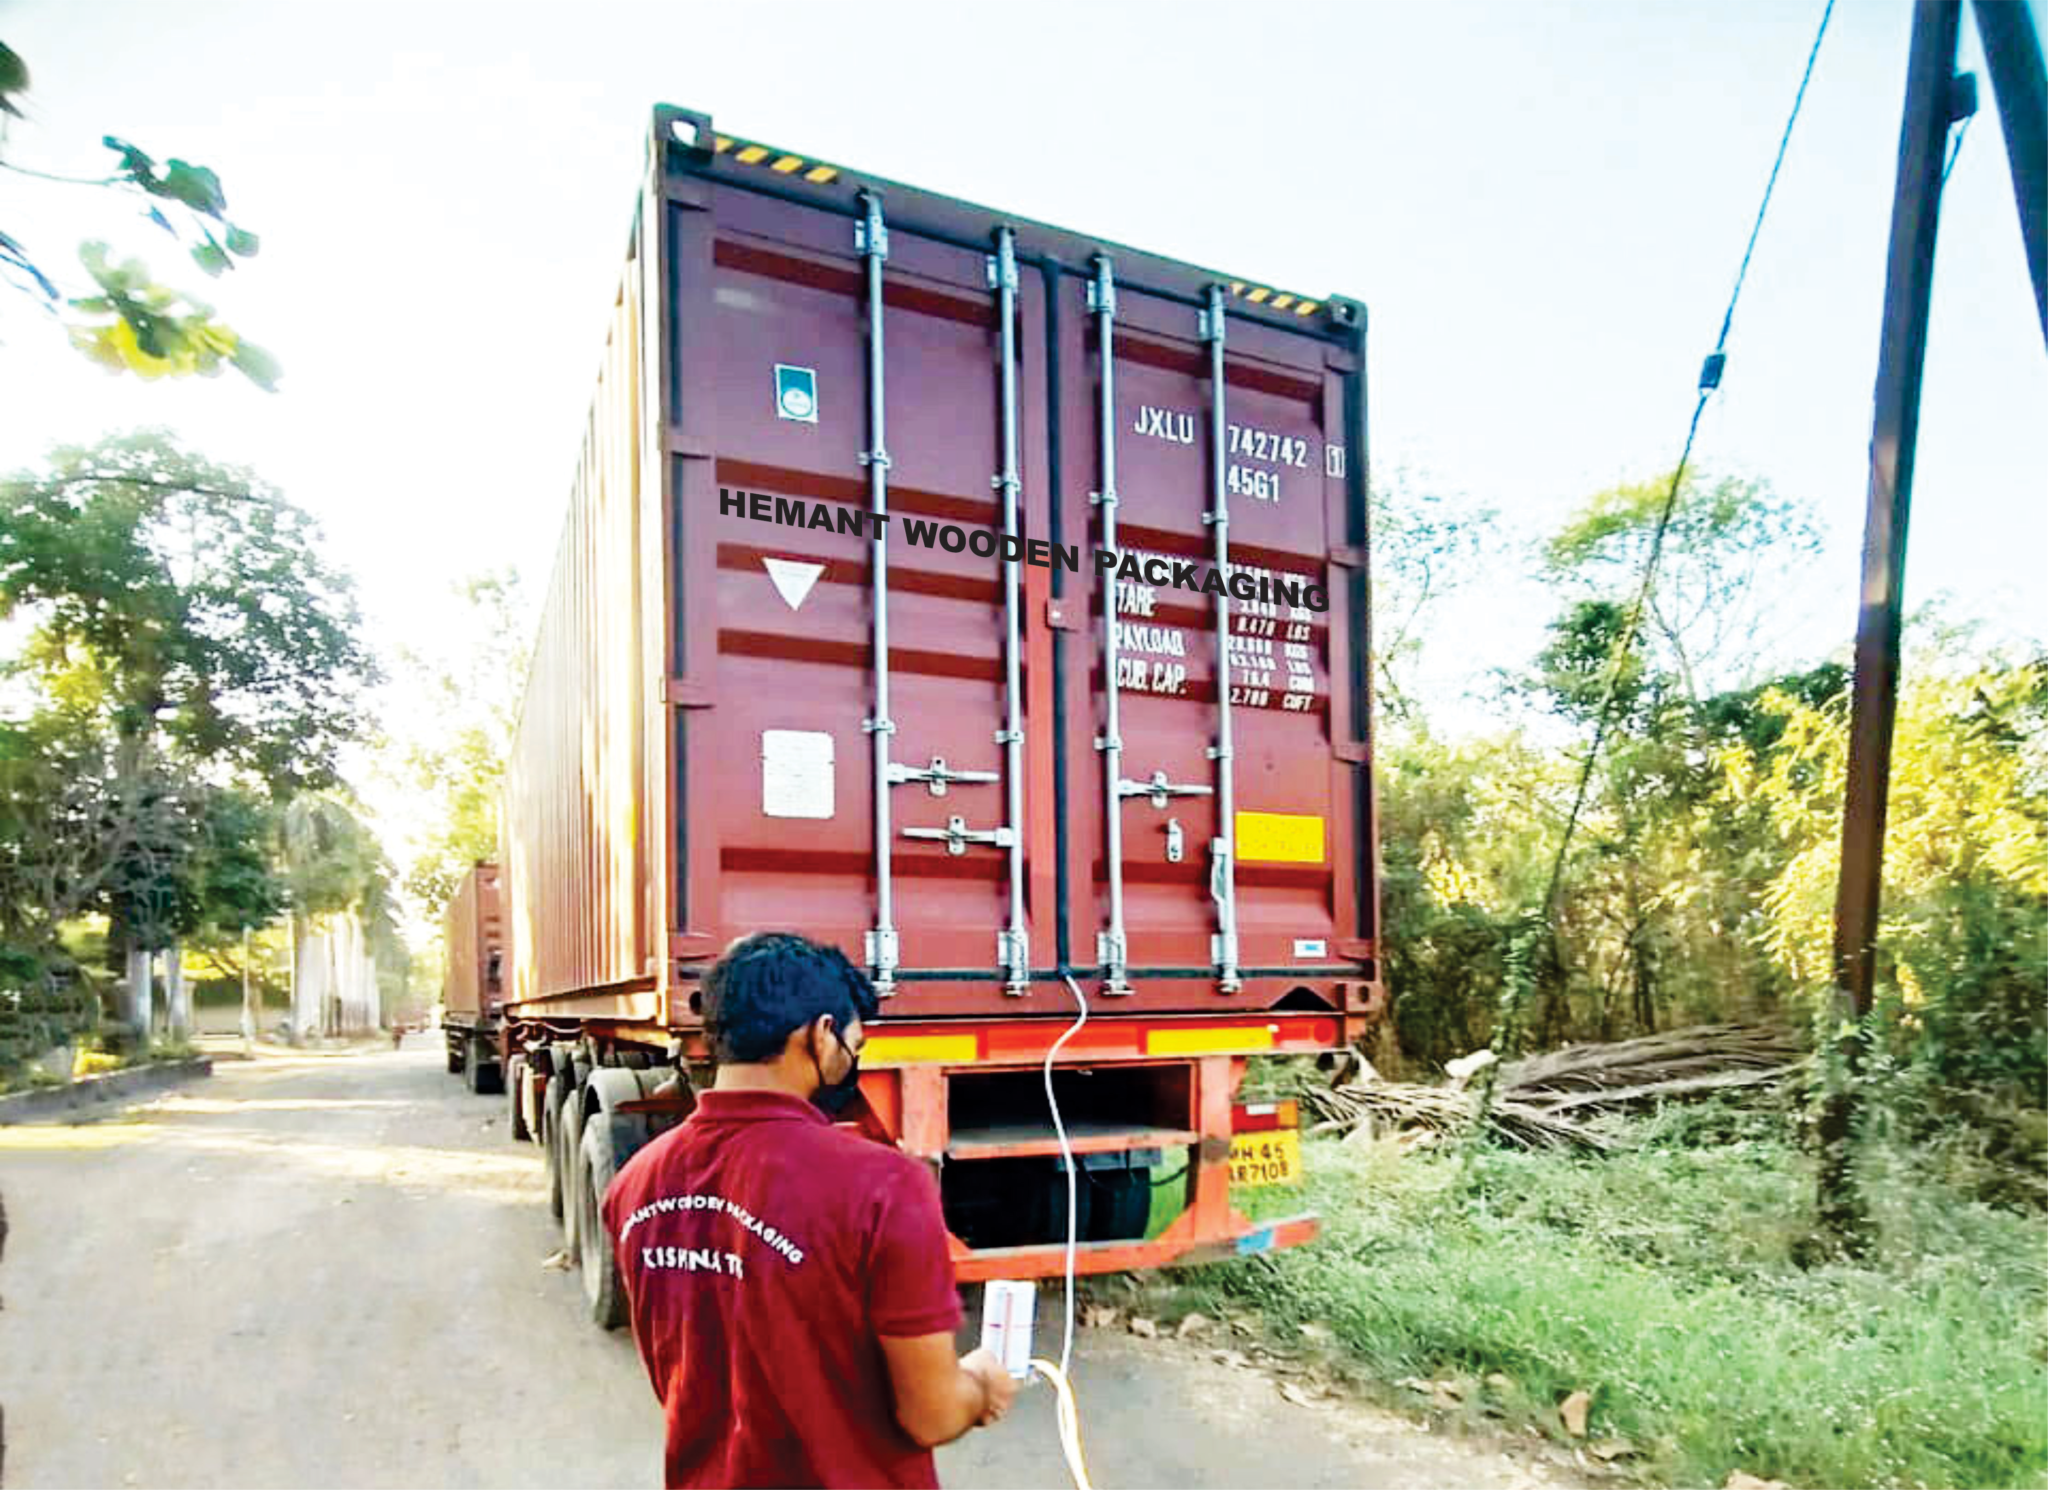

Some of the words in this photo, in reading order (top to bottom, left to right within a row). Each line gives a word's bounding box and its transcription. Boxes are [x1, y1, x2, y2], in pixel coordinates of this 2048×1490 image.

[1134, 405, 1194, 444] JXLU
[1228, 424, 1308, 469] 742742
[1326, 444, 1345, 479] 1
[1228, 464, 1280, 502] 45G1
[1117, 582, 1157, 617] TARE
